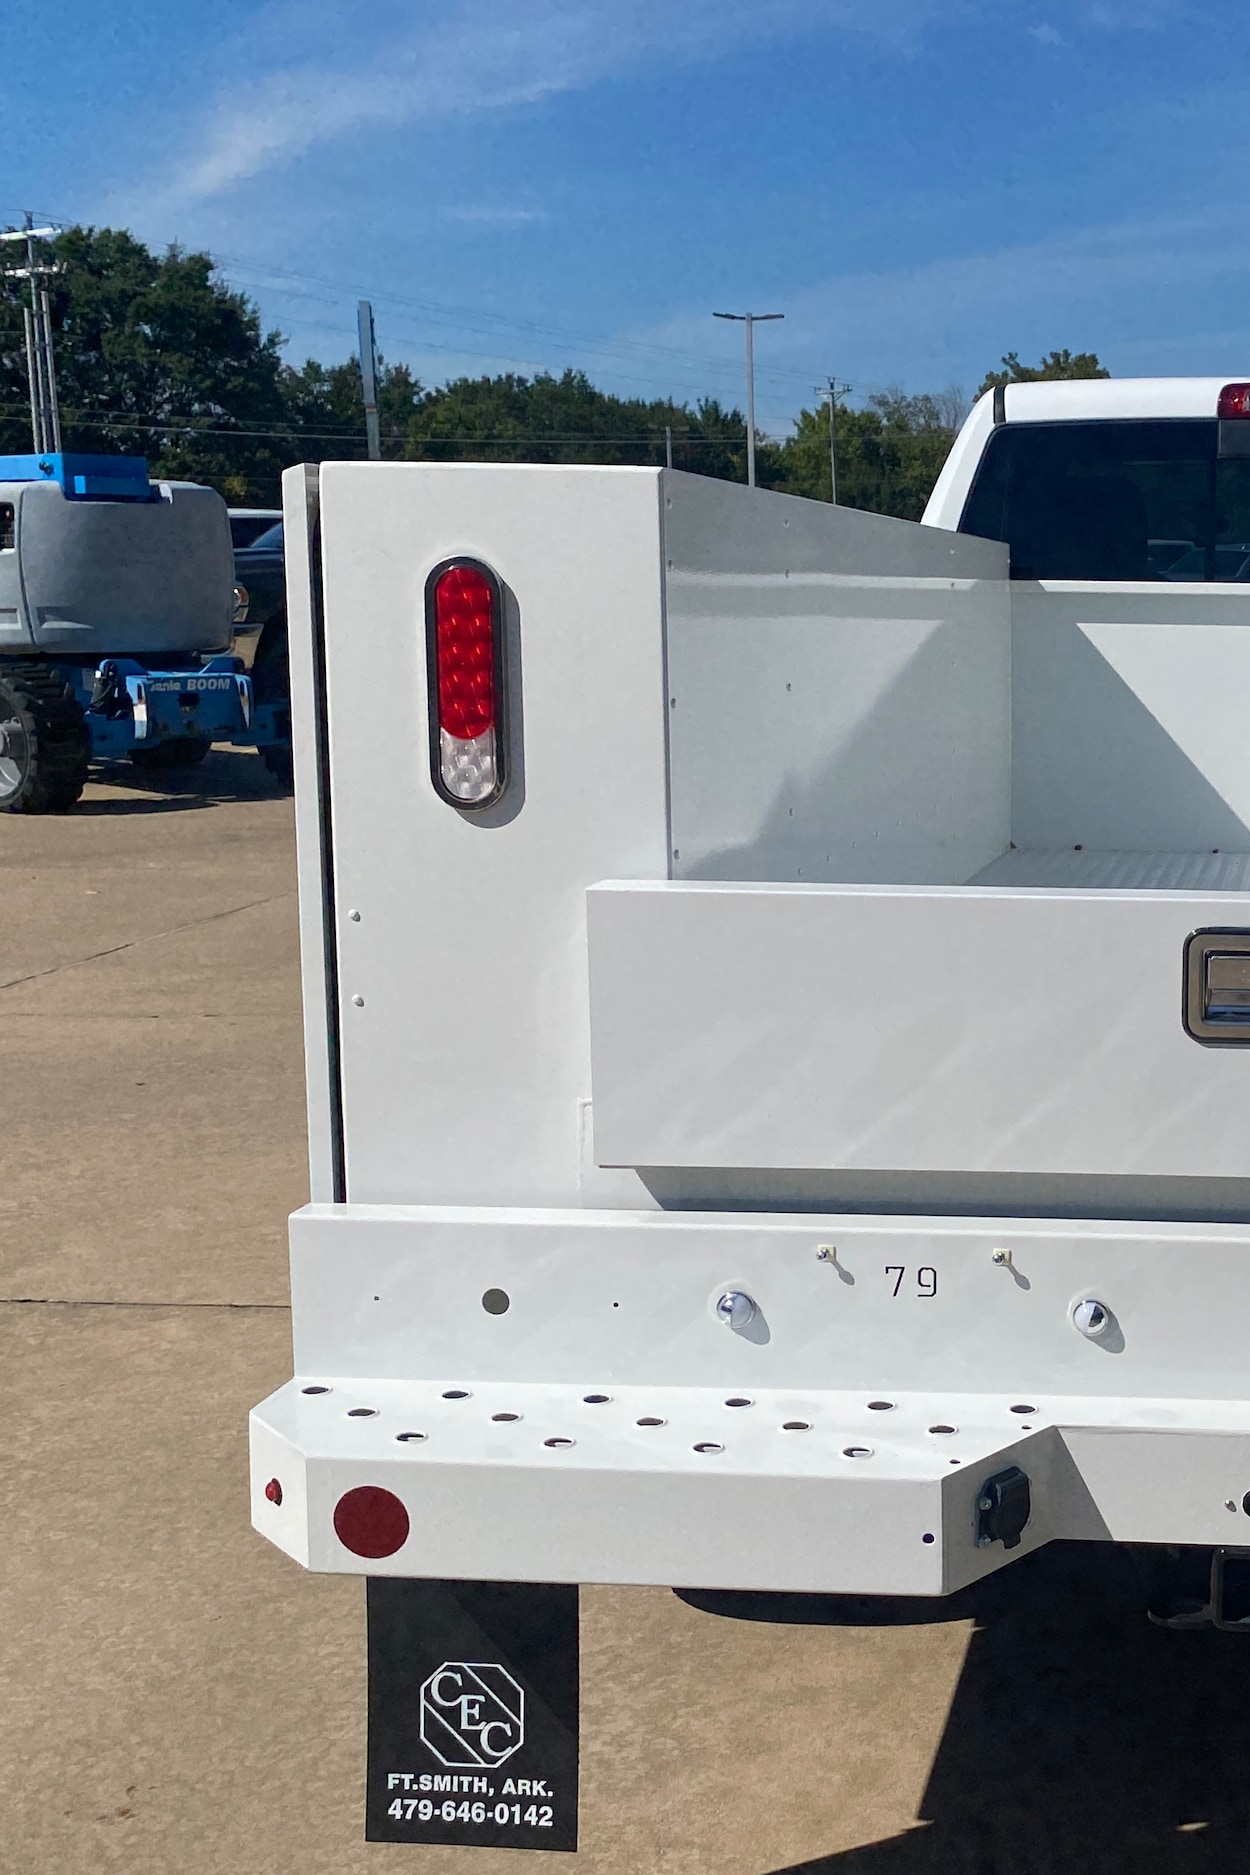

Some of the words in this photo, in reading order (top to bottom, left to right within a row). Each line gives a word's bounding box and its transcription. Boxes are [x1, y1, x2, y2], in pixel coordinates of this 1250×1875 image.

[186, 678, 231, 690] BOOM
[884, 1265, 938, 1298] 79
[430, 1671, 514, 1757] CEC
[386, 1773, 496, 1797] FT.SMITH,
[501, 1779, 554, 1797] ARK.
[386, 1798, 554, 1827] 479-646-0142
